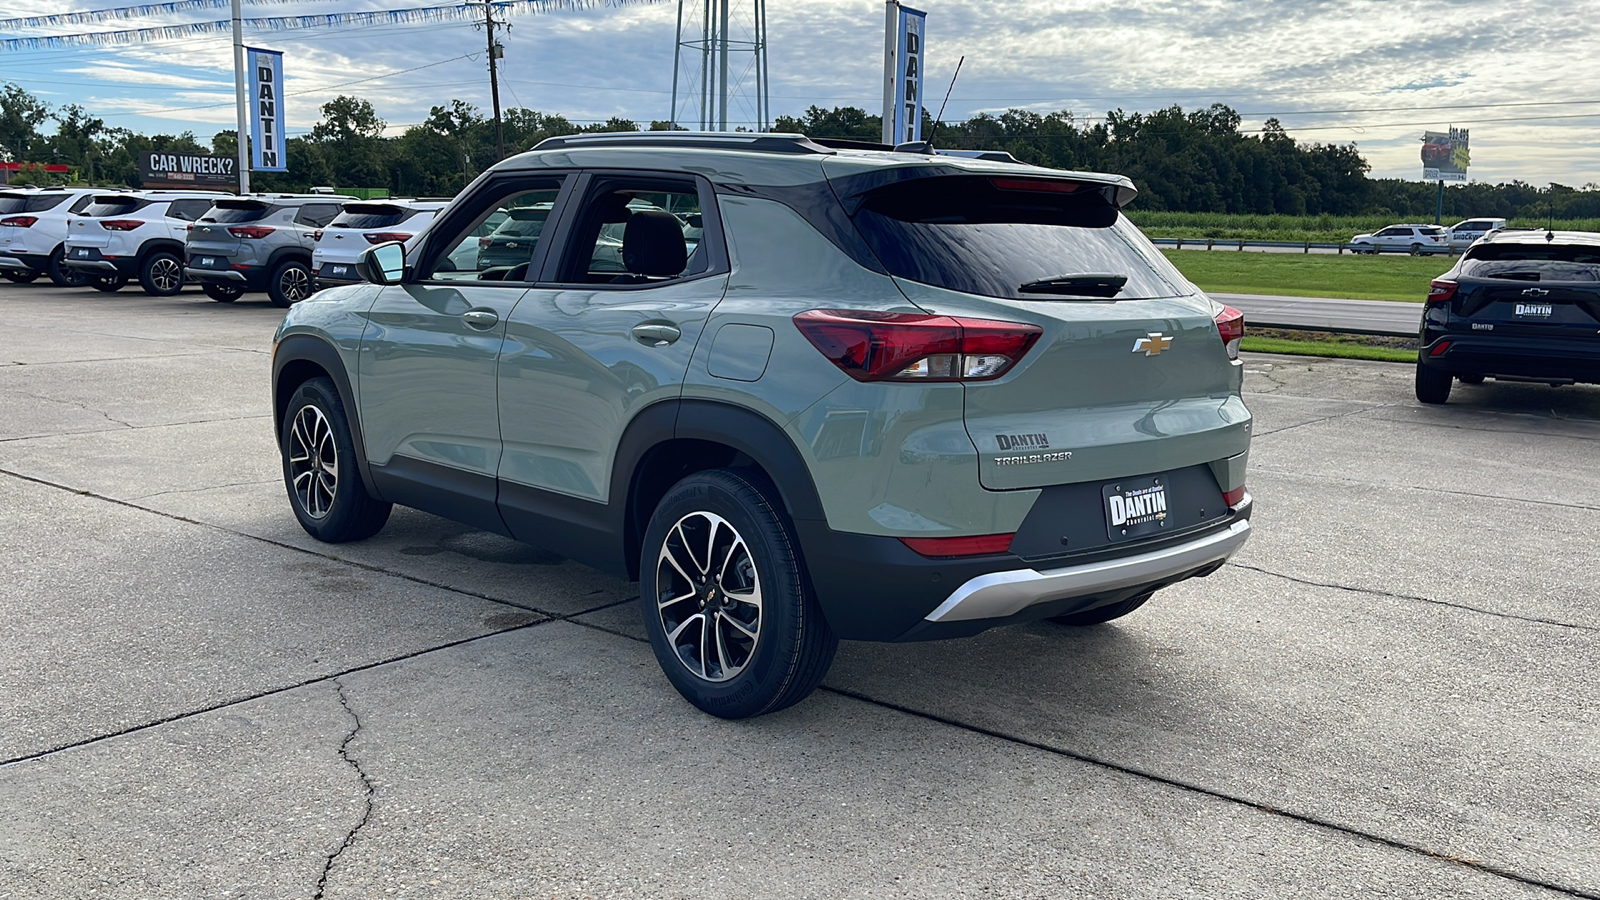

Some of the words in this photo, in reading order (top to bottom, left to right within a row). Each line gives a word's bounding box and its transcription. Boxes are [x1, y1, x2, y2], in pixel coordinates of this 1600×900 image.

[906, 32, 919, 141] DANTI
[258, 66, 277, 167] DANTIN
[150, 153, 177, 172] CAR
[180, 156, 233, 174] WRECK?
[1515, 304, 1552, 314] DANTIN
[995, 433, 1048, 450] DANTIN
[994, 452, 1072, 465] TRAILBLAZER
[1109, 491, 1166, 526] DANTIN
